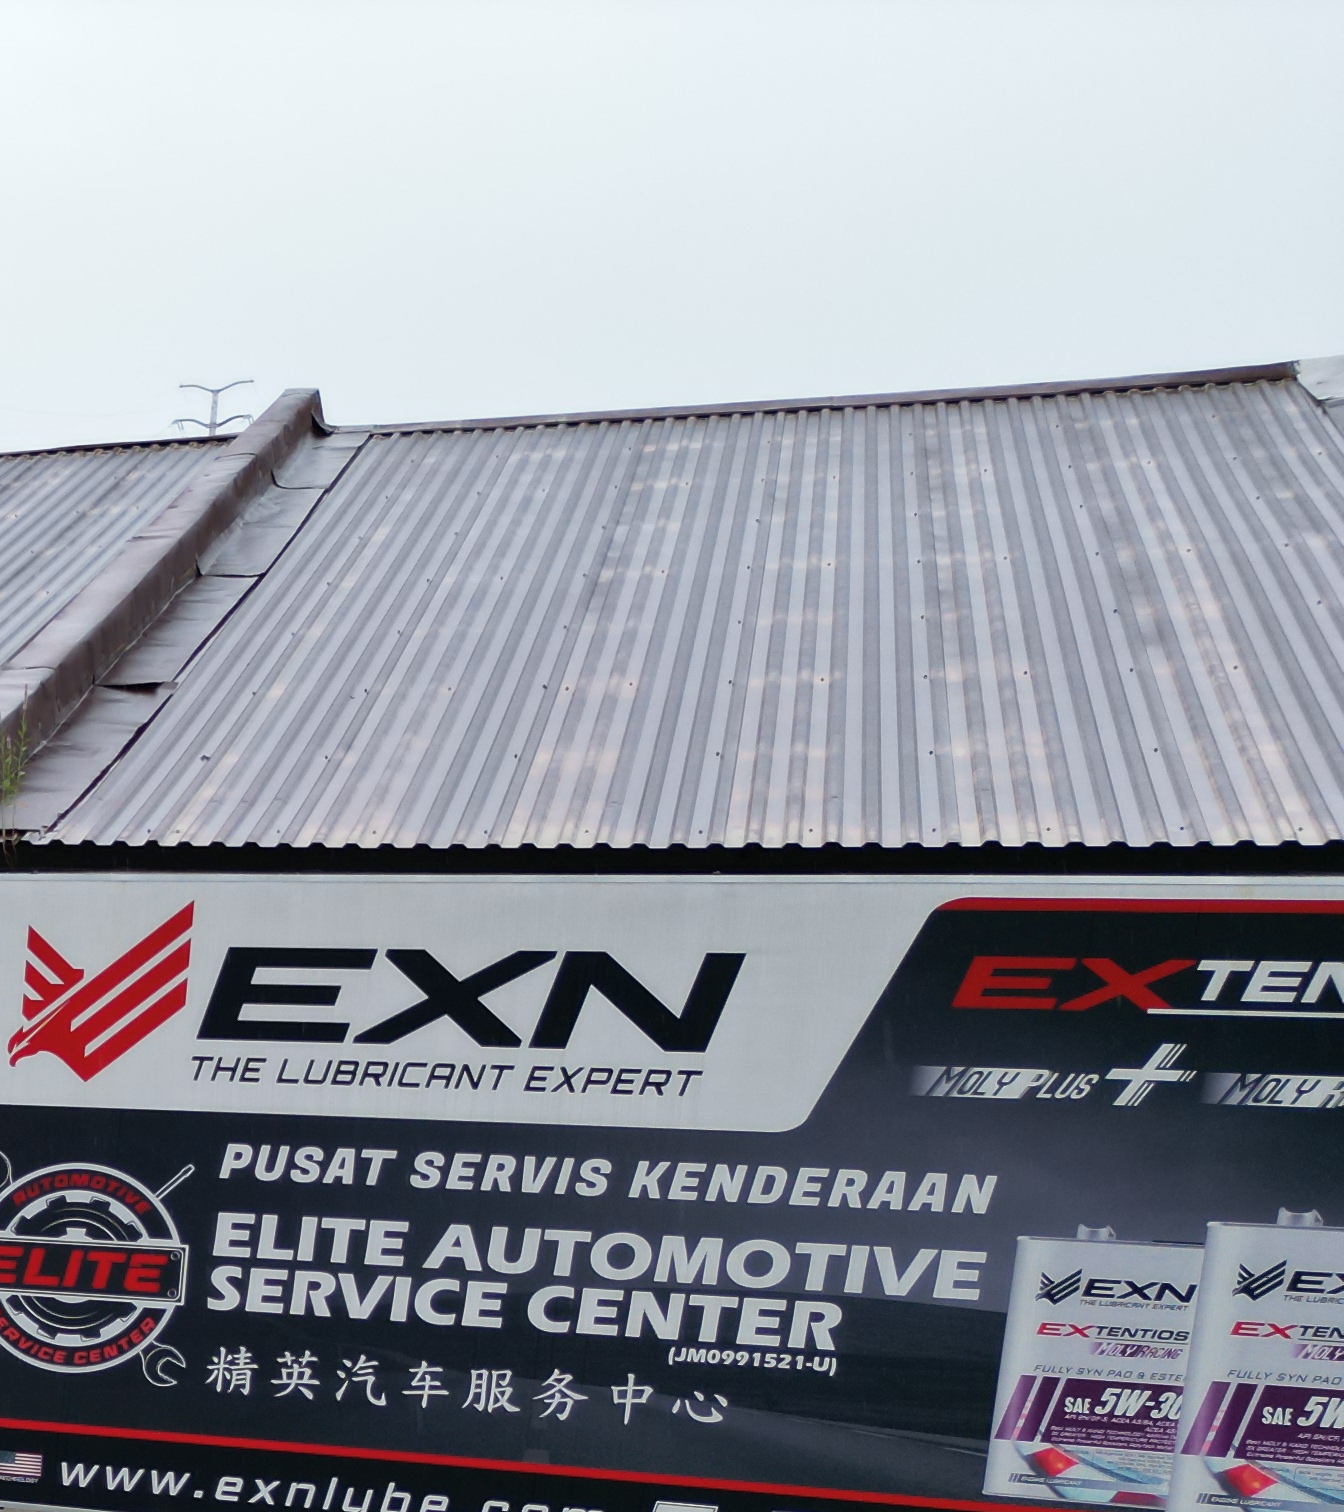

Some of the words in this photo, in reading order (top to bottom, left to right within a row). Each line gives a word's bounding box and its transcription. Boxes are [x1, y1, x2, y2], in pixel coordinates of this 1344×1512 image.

[196, 946, 747, 1054] EXN
[190, 1056, 275, 1084] THE
[276, 1058, 515, 1091] LUBRICANT
[523, 1065, 705, 1098] EXPERT
[13, 1173, 153, 1216] AUTOMOTIVE
[219, 1142, 397, 1187] PUSAT
[409, 1151, 612, 1198] SERVIS
[627, 1160, 998, 1214] KENDERAAN
[212, 1211, 410, 1267] ELITE
[422, 1223, 988, 1300] AUTOMOTIVE
[207, 1264, 504, 1329] SERVICE
[527, 1285, 843, 1351] CENTER
[1082, 1278, 1199, 1304] EXN
[73, 1315, 158, 1366] CENTER
[1036, 1322, 1191, 1341] EXTENTIOS
[667, 1347, 838, 1376] (JM0991521-U)
[1033, 1364, 1073, 1375] FULLY
[1076, 1367, 1104, 1377] SYN
[1227, 1369, 1273, 1380] FULLY
[1276, 1372, 1308, 1383] SYN
[205, 1346, 729, 1425] 精英汽车服务中心
[1064, 1397, 1091, 1414] SAE
[1261, 1407, 1294, 1426] SAE
